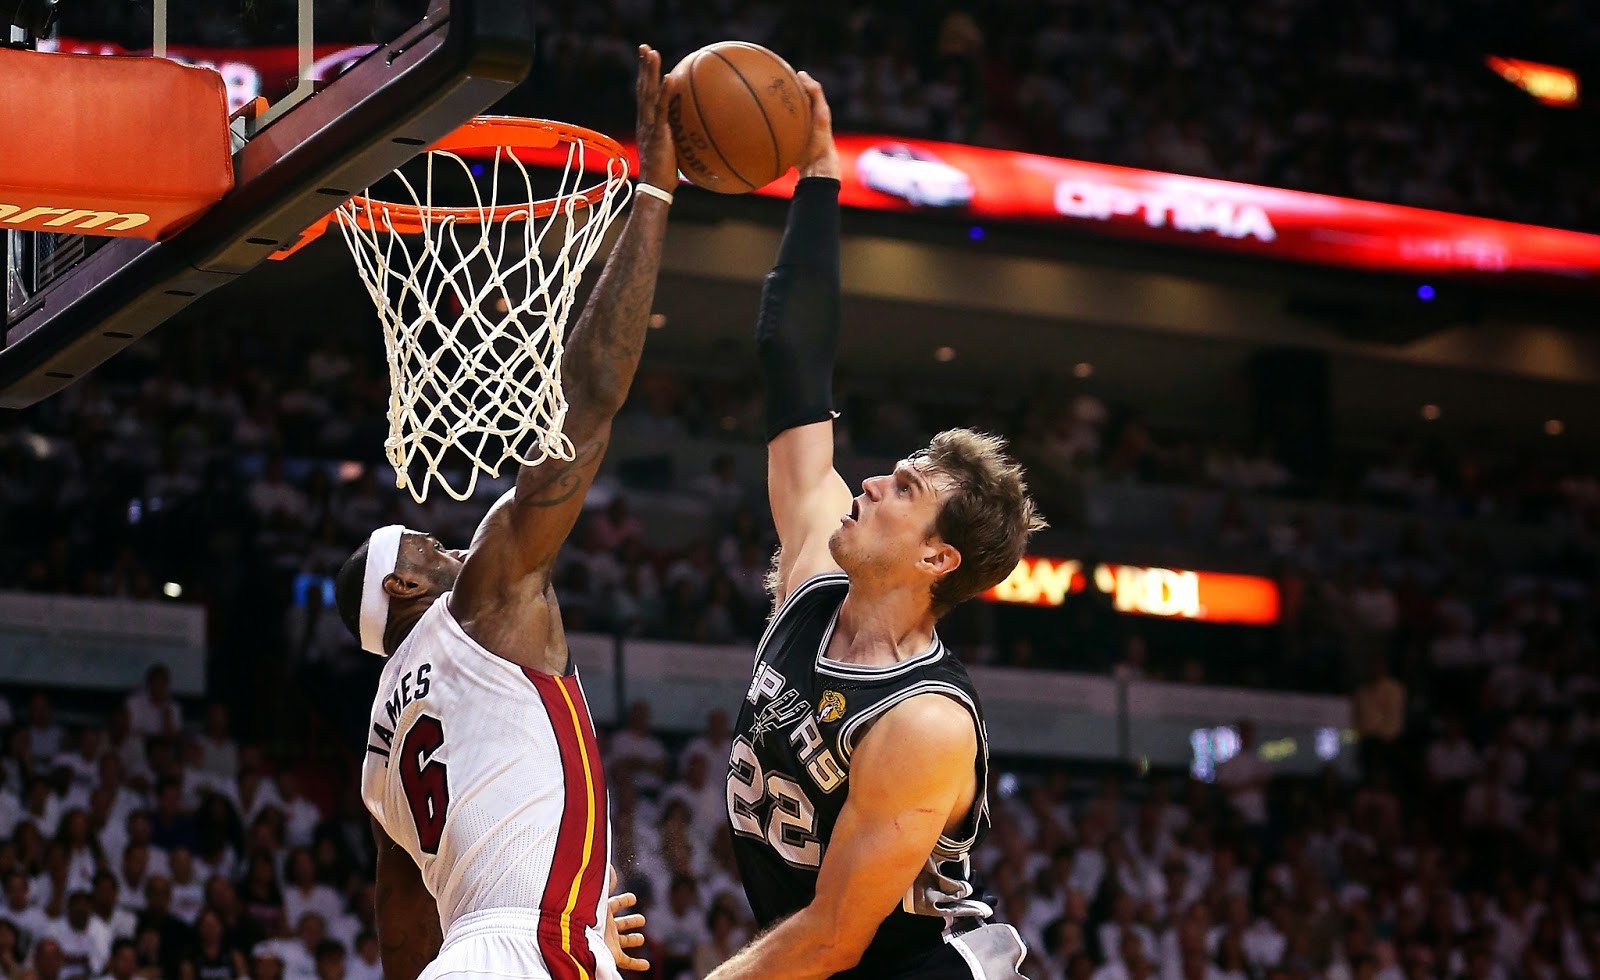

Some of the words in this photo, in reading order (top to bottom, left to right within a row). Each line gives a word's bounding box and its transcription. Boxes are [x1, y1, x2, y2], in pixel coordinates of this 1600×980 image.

[1054, 178, 1276, 241] OPTIMA
[367, 662, 432, 768] JAMES
[399, 712, 450, 855] 6
[726, 734, 823, 871] 22
